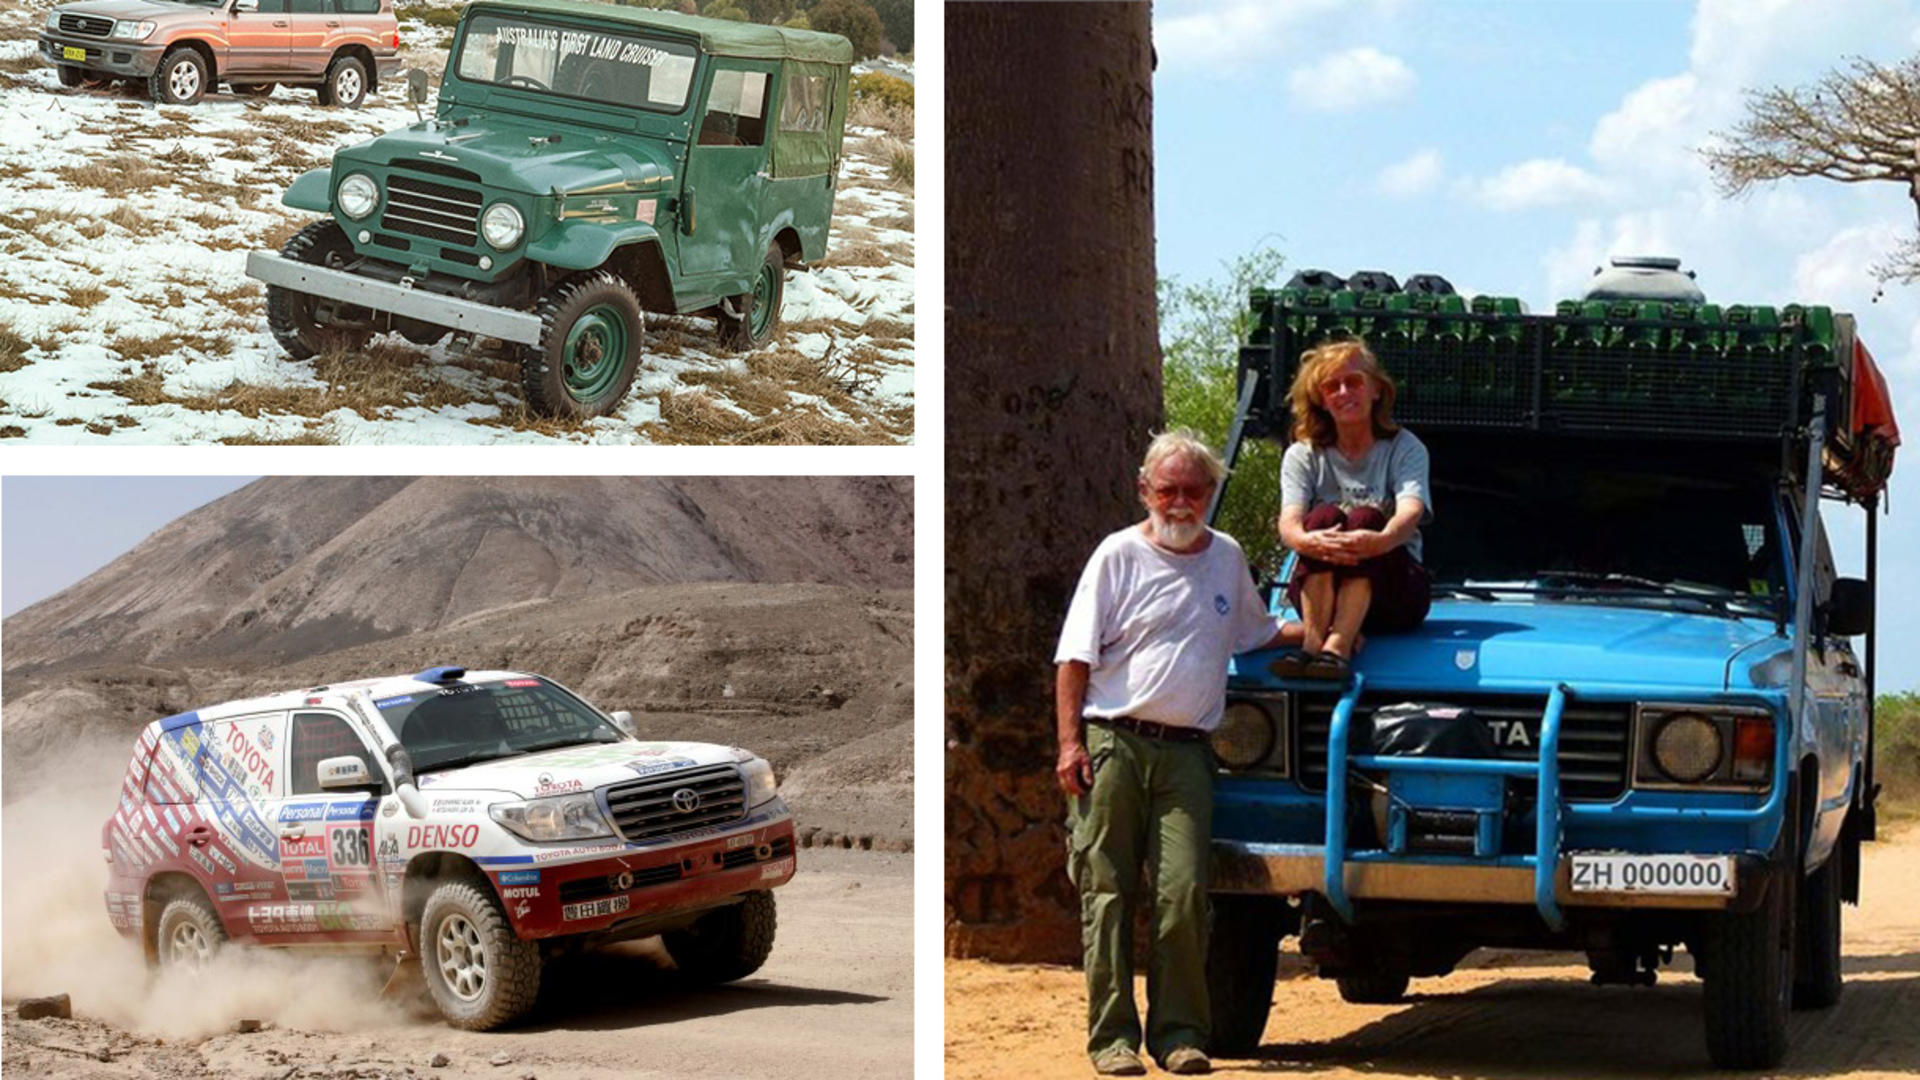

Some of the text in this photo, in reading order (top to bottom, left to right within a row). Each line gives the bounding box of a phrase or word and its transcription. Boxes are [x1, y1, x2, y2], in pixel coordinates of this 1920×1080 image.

[496, 26, 670, 67] AUSTRALIA'S FIRST LAND CRUISER
[1489, 720, 1531, 746] TA
[226, 720, 275, 794] TOYOTA
[280, 803, 326, 819] Personal
[280, 840, 324, 855] TOTAL
[333, 827, 370, 865] 336
[407, 824, 480, 849] DENSO
[535, 849, 572, 860] TOYOTA
[572, 846, 597, 854] AUTO
[1573, 862, 1722, 886] ZH 000000
[504, 887, 540, 899] MOTUL
